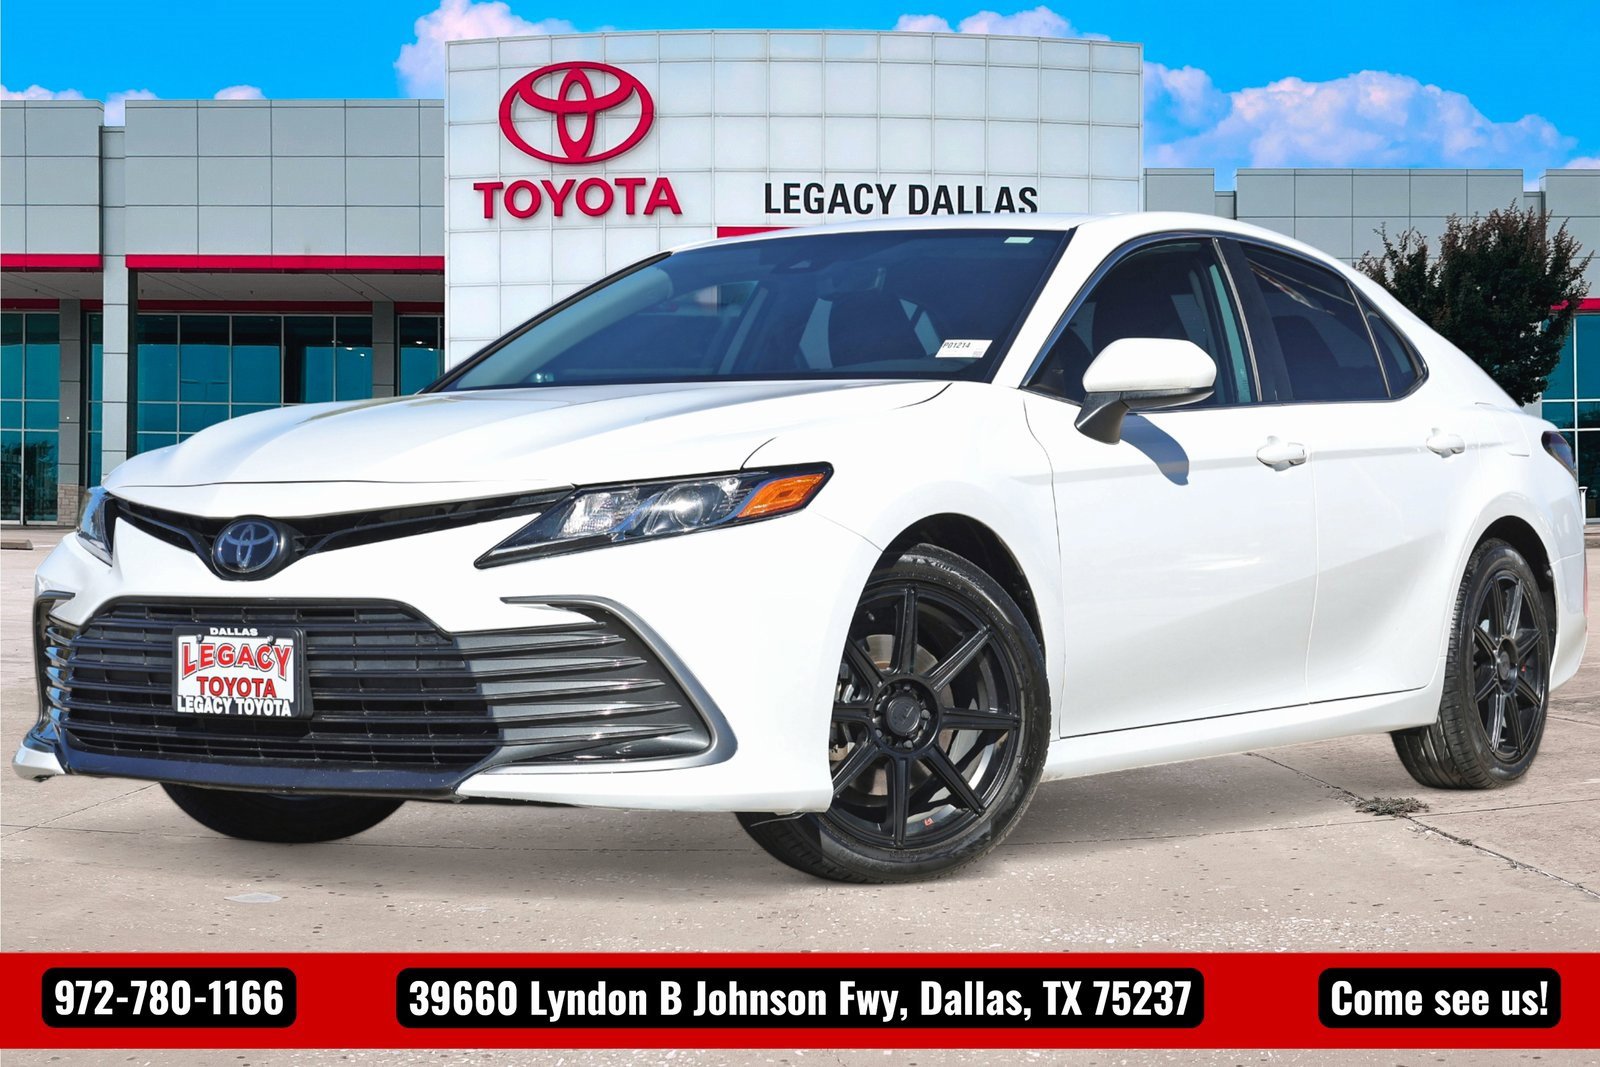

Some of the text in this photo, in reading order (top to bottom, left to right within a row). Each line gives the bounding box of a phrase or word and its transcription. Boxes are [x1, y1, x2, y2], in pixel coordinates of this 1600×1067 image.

[473, 177, 683, 219] TOYOTA
[765, 183, 1038, 215] LEGACY DALLAS
[209, 627, 258, 637] DALLAS
[181, 641, 294, 682] LEGACY
[196, 676, 277, 698] TOYOTA
[176, 695, 292, 717] LEGACY TOYOTA
